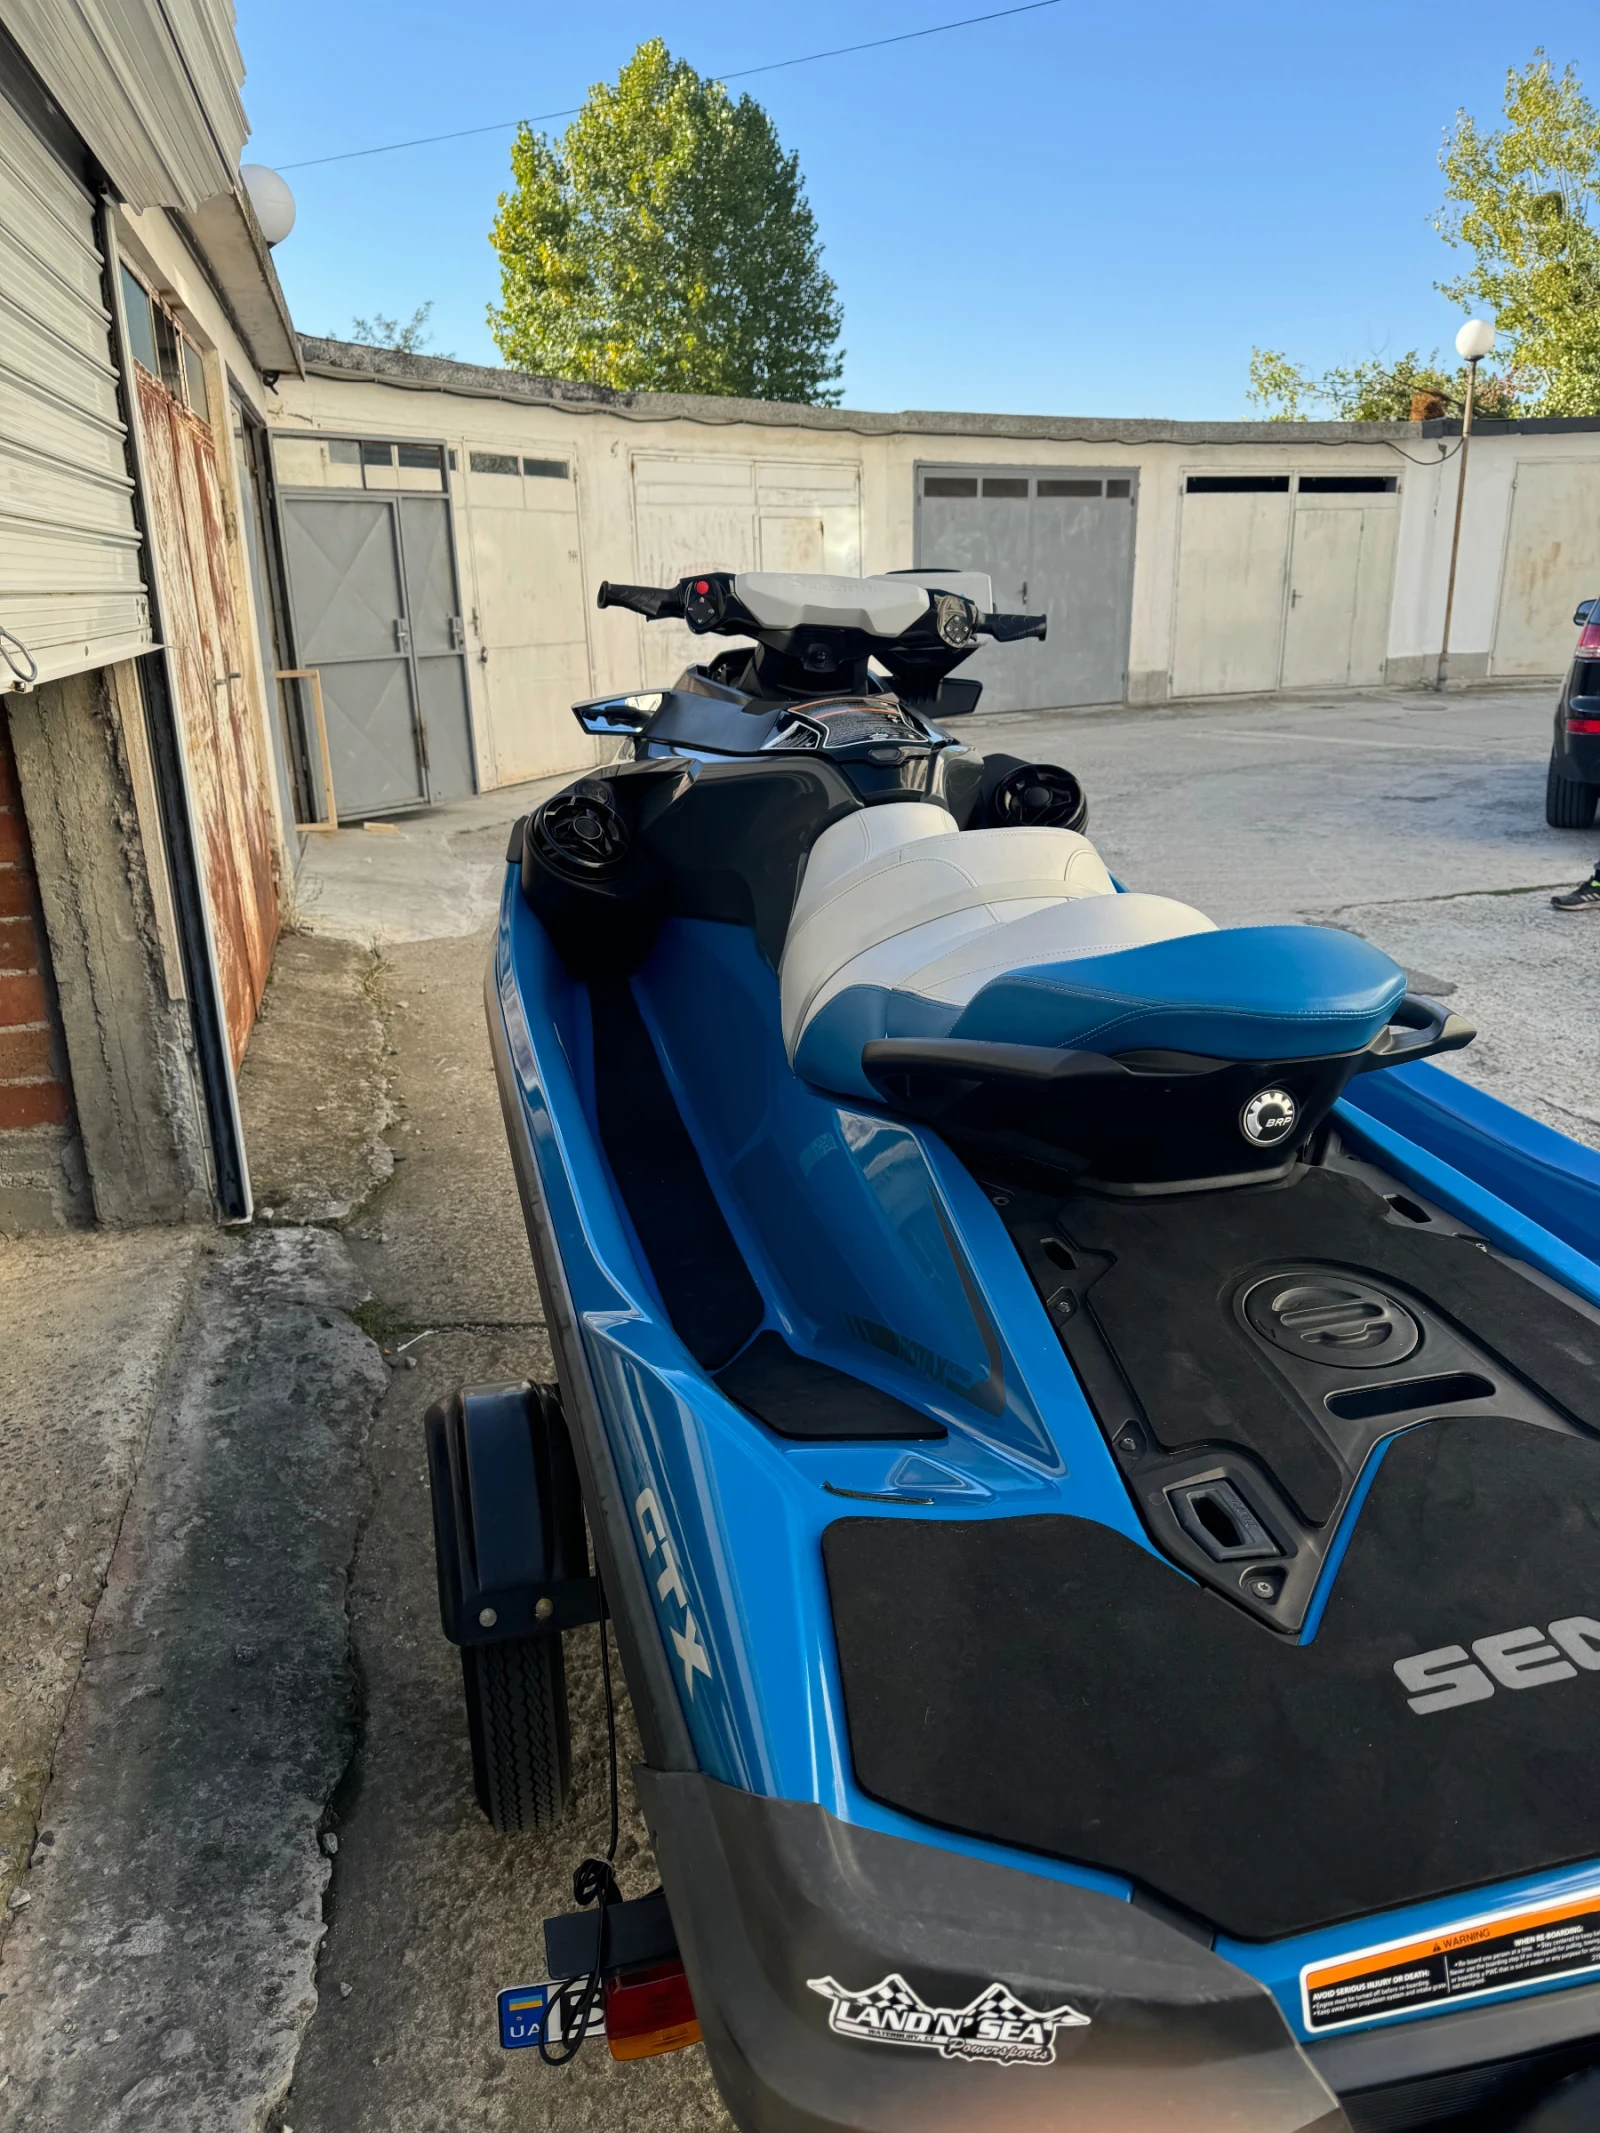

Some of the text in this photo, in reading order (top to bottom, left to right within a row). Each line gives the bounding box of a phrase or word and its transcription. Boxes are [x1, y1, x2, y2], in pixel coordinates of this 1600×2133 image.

[1265, 1116, 1292, 1128] BRP
[635, 1487, 712, 1702] GTX
[1443, 1928, 1490, 1950] WARNING
[1514, 1936, 1535, 1946] WHEN
[1541, 1940, 1552, 1949] Stay
[1486, 1958, 1507, 1969] boarding
[1509, 1955, 1519, 1964] step
[1313, 1969, 1430, 2001] AVOID SERIOUS INJURY OR DEATH:
[1316, 2000, 1334, 2011] Engine
[1335, 1997, 1347, 2005] must
[1356, 1992, 1372, 2001] turned
[1381, 1986, 1398, 1995] before
[1317, 2008, 1330, 2018] Keep
[1332, 2006, 1345, 2014] away
[1346, 2002, 1357, 2010] from
[1359, 1996, 1385, 2008] propulsion
[1386, 1992, 1405, 2002] system
[1406, 1989, 1415, 1997] and
[1416, 1986, 1431, 1994] intake
[510, 2023, 540, 2038] UA
[836, 2000, 932, 2033] LAND
[976, 2019, 1044, 2044] SEA
[867, 2028, 922, 2041] WATERBURY,
[948, 2037, 1049, 2060] Powersports
